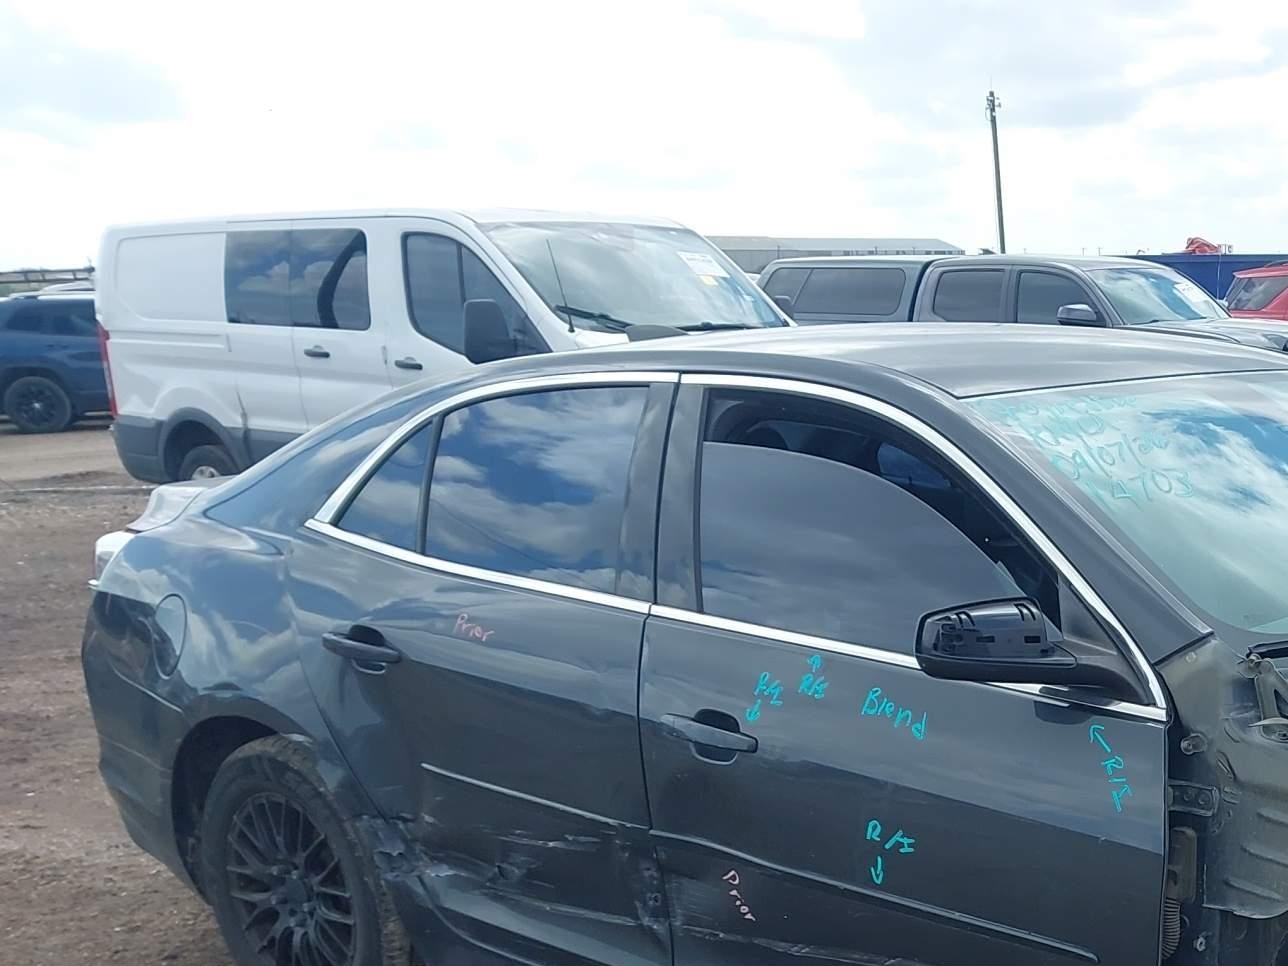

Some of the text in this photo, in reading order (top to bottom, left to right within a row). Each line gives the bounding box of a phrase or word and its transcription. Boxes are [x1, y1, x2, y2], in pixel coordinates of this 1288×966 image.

[453, 612, 496, 642] Prior
[861, 687, 928, 741] Blend
[721, 869, 757, 922] Prior
